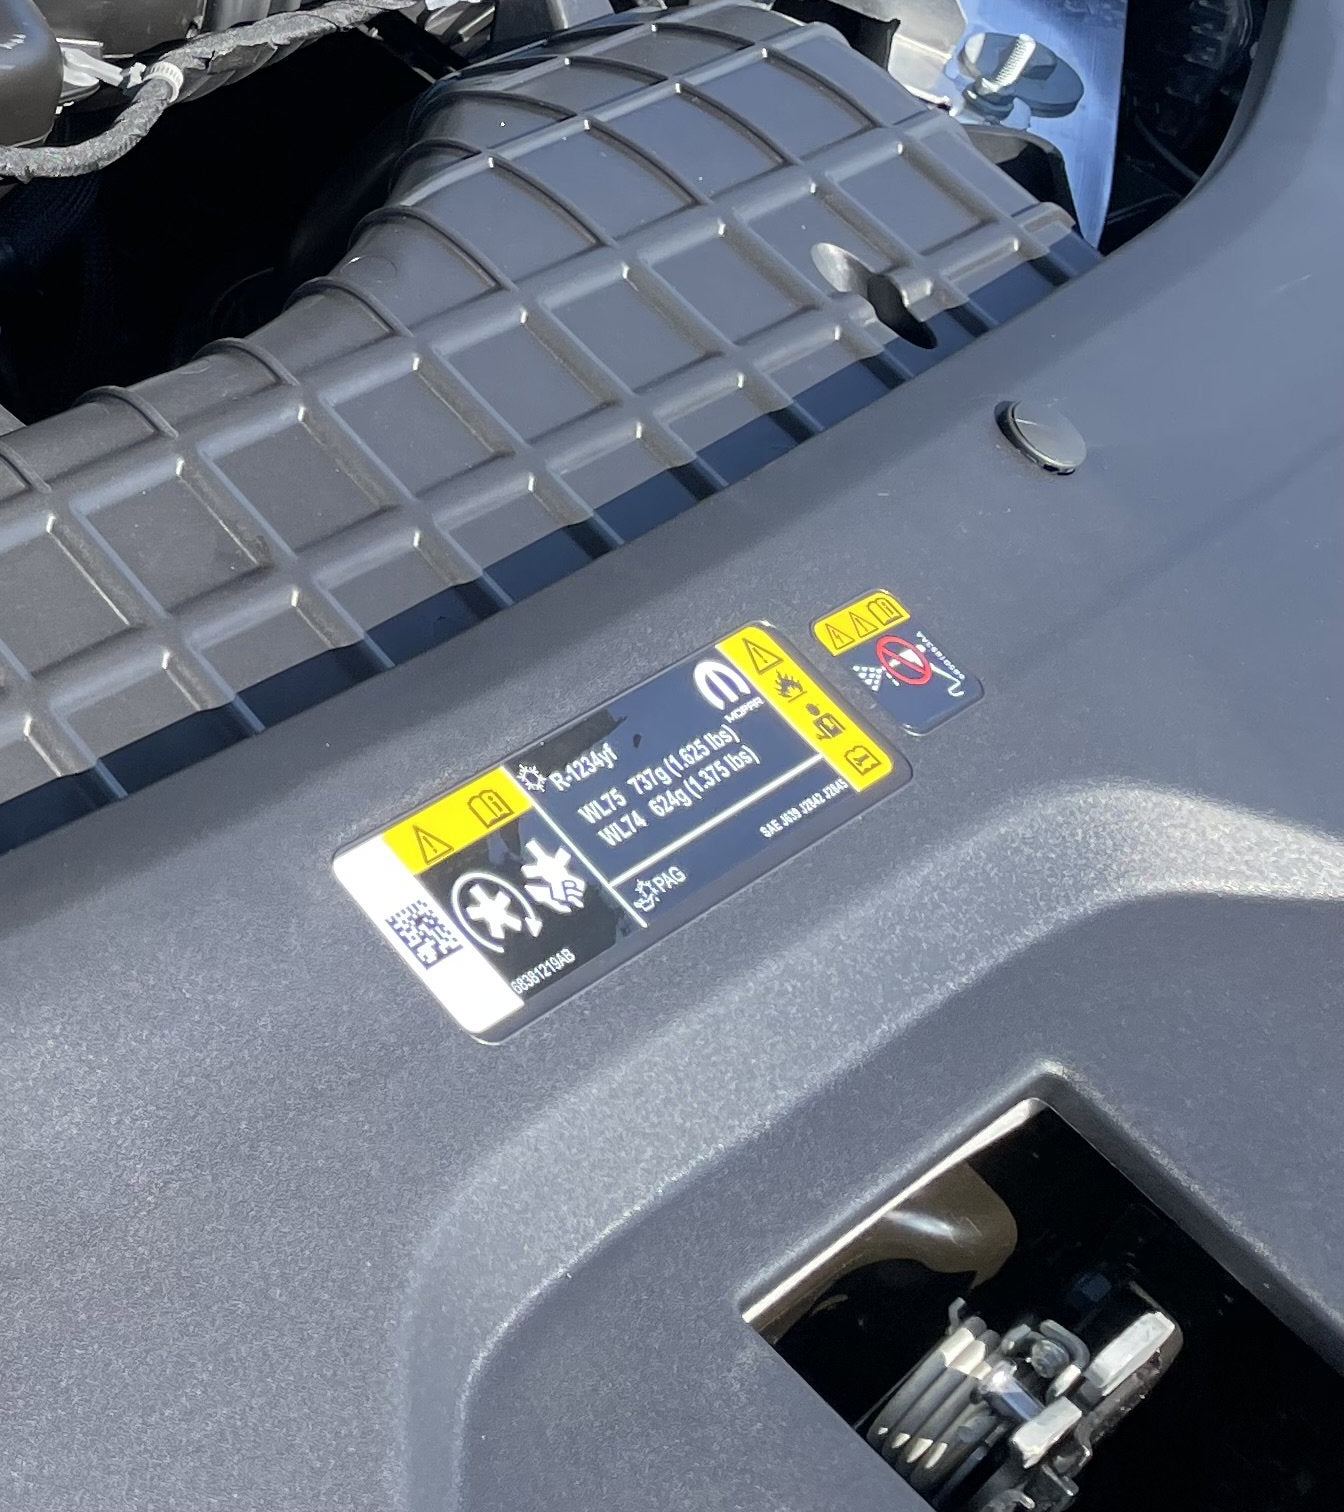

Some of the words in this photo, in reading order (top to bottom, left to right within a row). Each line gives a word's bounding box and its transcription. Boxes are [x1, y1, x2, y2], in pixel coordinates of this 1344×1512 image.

[724, 696, 765, 724] MOPAR
[549, 742, 618, 792] R-1234yf
[577, 787, 628, 824] WL75
[627, 768, 673, 795] 737g
[664, 738, 711, 778] (1.625
[703, 724, 741, 751] lbs)
[598, 810, 649, 847] WL74
[648, 788, 693, 817] 624g
[684, 760, 732, 800] (1.375
[723, 744, 761, 772] lbs)
[759, 819, 784, 838] SAE
[780, 807, 803, 827] J639
[652, 864, 686, 893] PAG
[510, 947, 577, 995] 68381219AB
